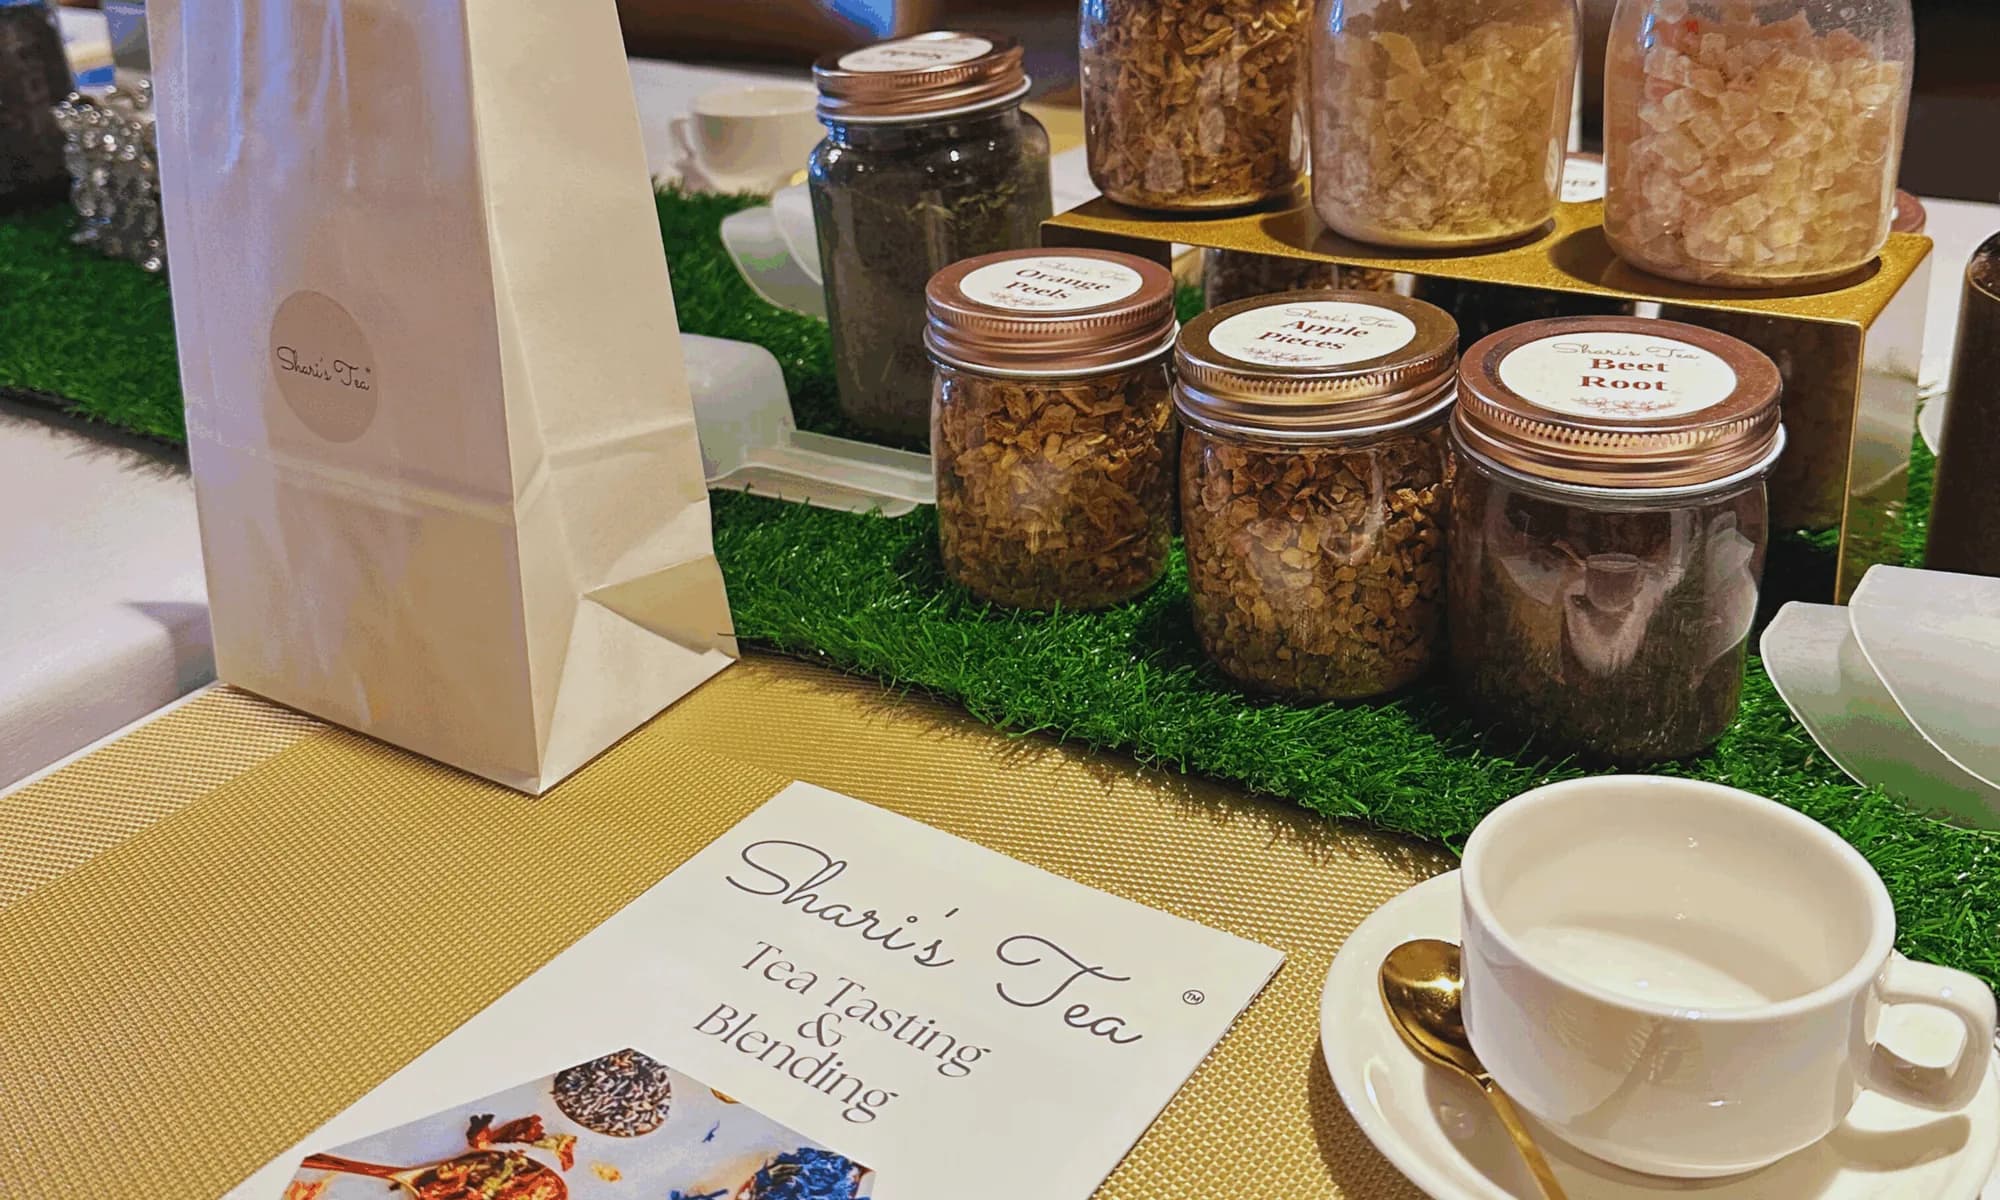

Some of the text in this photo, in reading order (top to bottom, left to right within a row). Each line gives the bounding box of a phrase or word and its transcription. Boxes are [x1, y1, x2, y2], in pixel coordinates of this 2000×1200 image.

[1005, 280, 1072, 300] Peels
[1015, 268, 1112, 292] Orange
[1281, 320, 1369, 338] Apple
[1255, 331, 1347, 350] Pieces
[1552, 342, 1700, 360] Shari's Tea
[276, 346, 370, 391] Shari's Tea
[1590, 358, 1670, 373] Beet
[1578, 375, 1670, 392] Root
[725, 839, 959, 968] Shari's
[995, 934, 1144, 1046] Tea
[739, 940, 992, 1079] Tea Tasting
[795, 1011, 847, 1048] &
[692, 1002, 900, 1125] Blending
